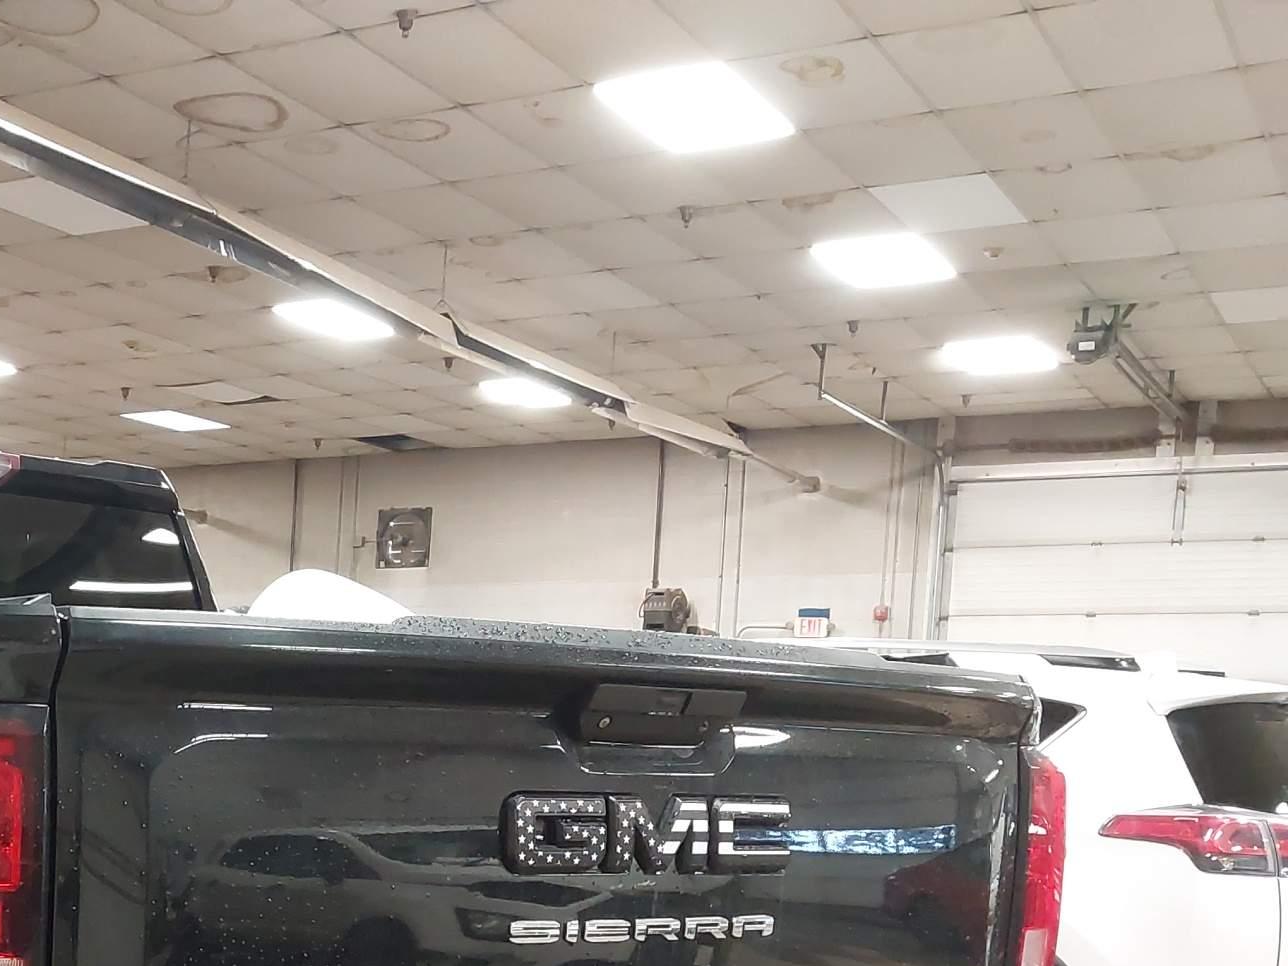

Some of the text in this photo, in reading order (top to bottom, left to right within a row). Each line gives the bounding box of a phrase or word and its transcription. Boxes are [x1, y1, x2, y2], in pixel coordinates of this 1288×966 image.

[800, 618, 823, 634] EXIT
[499, 790, 791, 875] GMC
[508, 914, 775, 945] SIERRA
